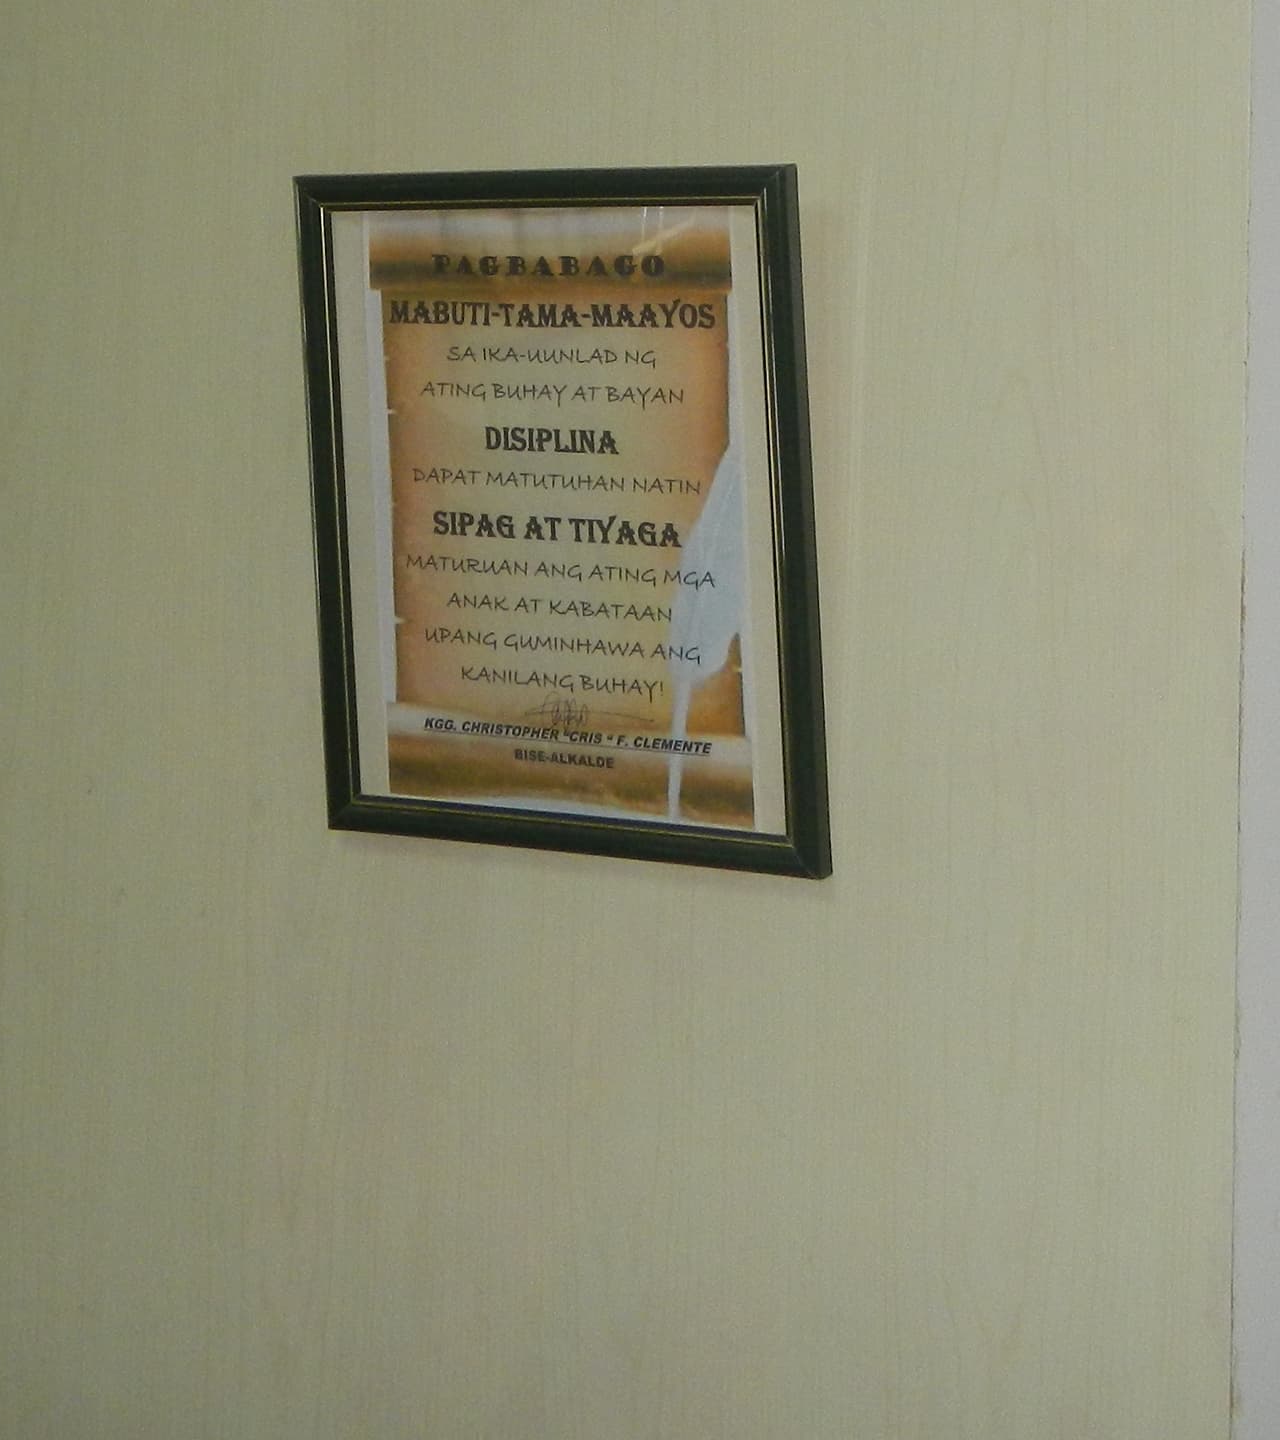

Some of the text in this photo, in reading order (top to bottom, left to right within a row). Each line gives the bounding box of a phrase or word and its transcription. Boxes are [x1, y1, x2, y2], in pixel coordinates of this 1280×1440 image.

[431, 254, 665, 278] PAGBABAGO
[389, 298, 717, 330] MABUTI-TAMA-MAAYOS
[446, 346, 658, 368] SA IKA-UUNLAD NG
[420, 381, 685, 410] ATING BUHAY AT BAYAN
[484, 425, 620, 456] DISIPLINA
[412, 466, 702, 496] DAPAT MATUTUHAN NATIN
[432, 510, 684, 549] SIPAG AT TIYAGA
[406, 554, 717, 590] MATURUAN ANG ATING MGA
[446, 591, 673, 624] ANAK AT KABATAAN
[424, 626, 702, 666] UPANG GUMINHAWA ANG
[460, 665, 665, 703] KANILANG BUHAY!
[424, 716, 457, 732] KGG.
[461, 720, 560, 742] CHRISTOPHER
[616, 734, 631, 748] F.
[633, 737, 713, 755] CLEMENTE
[513, 747, 616, 770] BISE-ALKALDE
